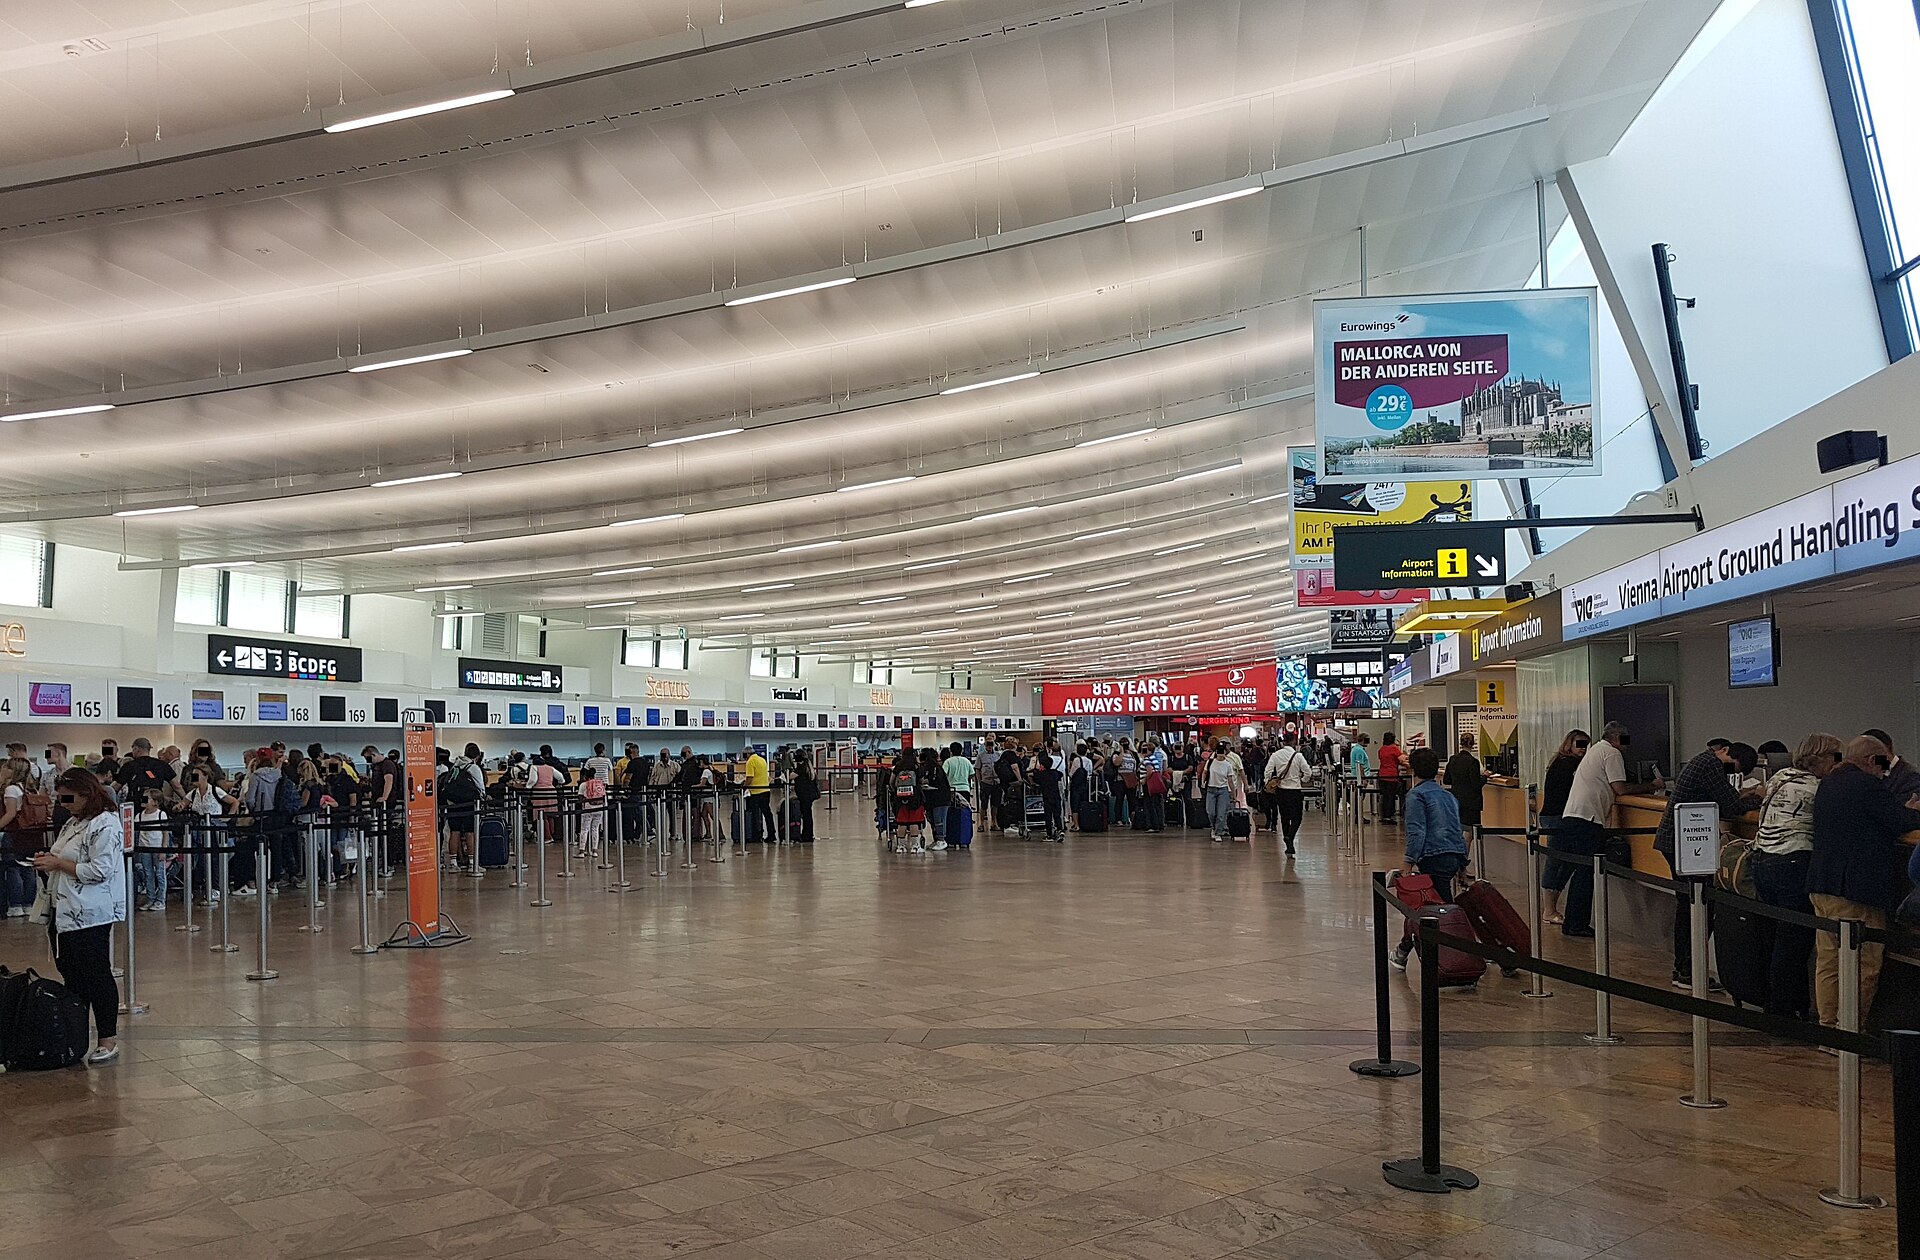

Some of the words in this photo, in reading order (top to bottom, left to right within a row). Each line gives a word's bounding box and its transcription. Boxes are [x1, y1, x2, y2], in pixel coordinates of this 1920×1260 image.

[1340, 321, 1396, 333] Eurowings
[1341, 343, 1425, 362] MALLORCA
[1427, 342, 1461, 358] VON
[1341, 365, 1371, 381] DER
[1375, 361, 1449, 379] ANDEREN
[1453, 359, 1498, 376] SEITE.
[1302, 522, 1319, 533] Ihr
[1302, 538, 1323, 548] AM
[1618, 578, 1658, 610] Vienna
[1662, 556, 1713, 600] Airport
[1718, 528, 1782, 581] Ground
[1790, 498, 1900, 562] Handling
[1402, 559, 1434, 570] Airport
[1381, 569, 1434, 580] Information
[1351, 629, 1390, 637] STAATSGAST
[1480, 631, 1499, 657] Airport
[1500, 613, 1542, 650] Information
[275, 655, 283, 671] 3
[1092, 681, 1112, 696] 85
[1118, 678, 1168, 695] YEARS
[1218, 687, 1256, 696] TURKISH
[1063, 697, 1123, 713] ALWAYS
[1128, 696, 1145, 712] IN
[1150, 694, 1199, 712] STYLE
[1217, 695, 1257, 705] AIRLINES
[76, 701, 101, 718] 165
[157, 704, 180, 719] 166
[227, 706, 246, 720] 167
[291, 708, 309, 722] 168
[348, 710, 366, 723] 169
[448, 712, 460, 724] 171
[490, 714, 502, 725] 172
[530, 714, 541, 725] 173
[566, 715, 577, 725] 174
[601, 716, 610, 726] 175
[661, 717, 670, 726] 177
[1198, 716, 1229, 725] BURGER
[1230, 716, 1251, 724] KING
